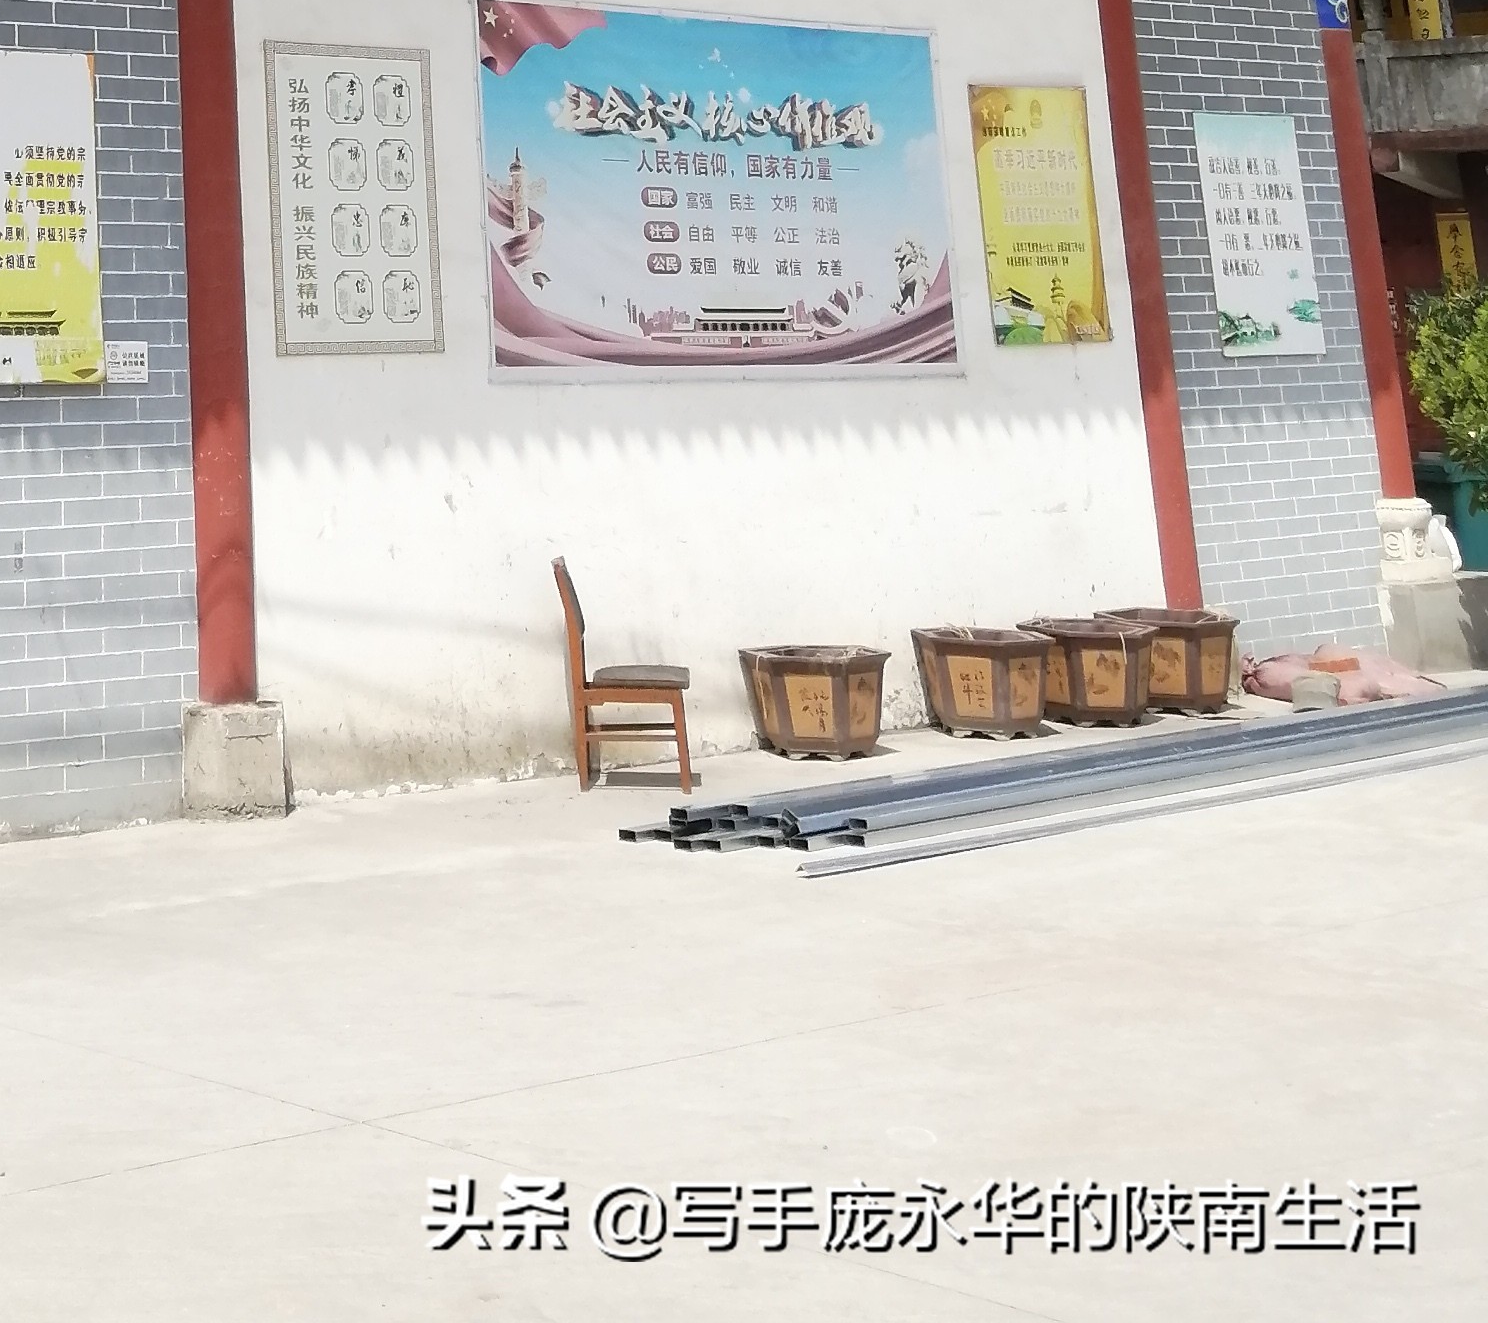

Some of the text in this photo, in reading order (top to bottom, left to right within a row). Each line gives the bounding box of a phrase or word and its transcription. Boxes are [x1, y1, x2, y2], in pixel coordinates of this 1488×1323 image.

[288, 77, 319, 319] 弘扬中华文化 振兴民族精神
[647, 190, 839, 214] 国家 富强 民主 文明 和谐
[648, 223, 841, 246] 社会 自由 平等 公正 法治
[651, 255, 844, 278] 公民 爱国 敬业 诚信 友善
